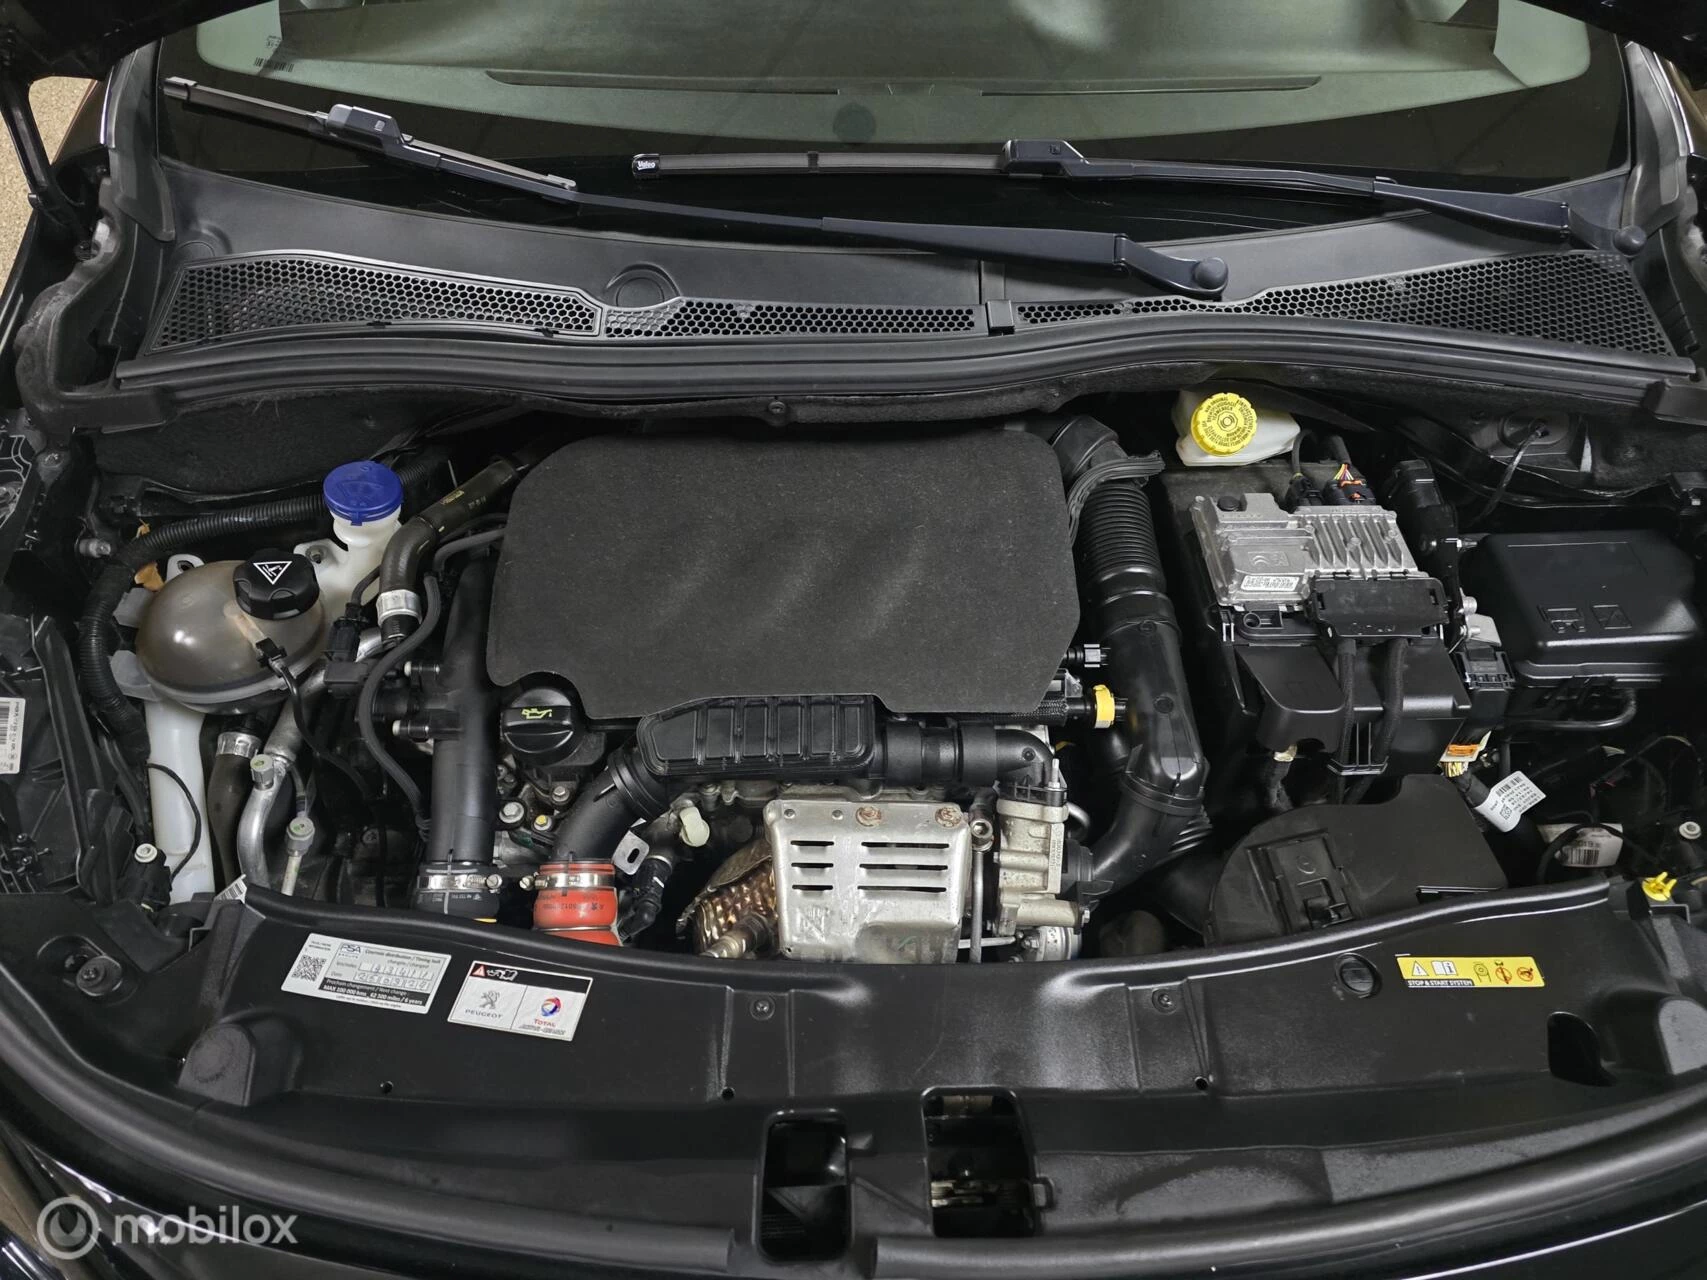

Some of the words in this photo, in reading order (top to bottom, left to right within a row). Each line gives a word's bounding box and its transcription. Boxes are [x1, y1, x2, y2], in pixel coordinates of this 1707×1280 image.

[637, 161, 656, 170] Valeo
[465, 1009, 503, 1019] PEUGEOT
[534, 1018, 556, 1028] TOTAL
